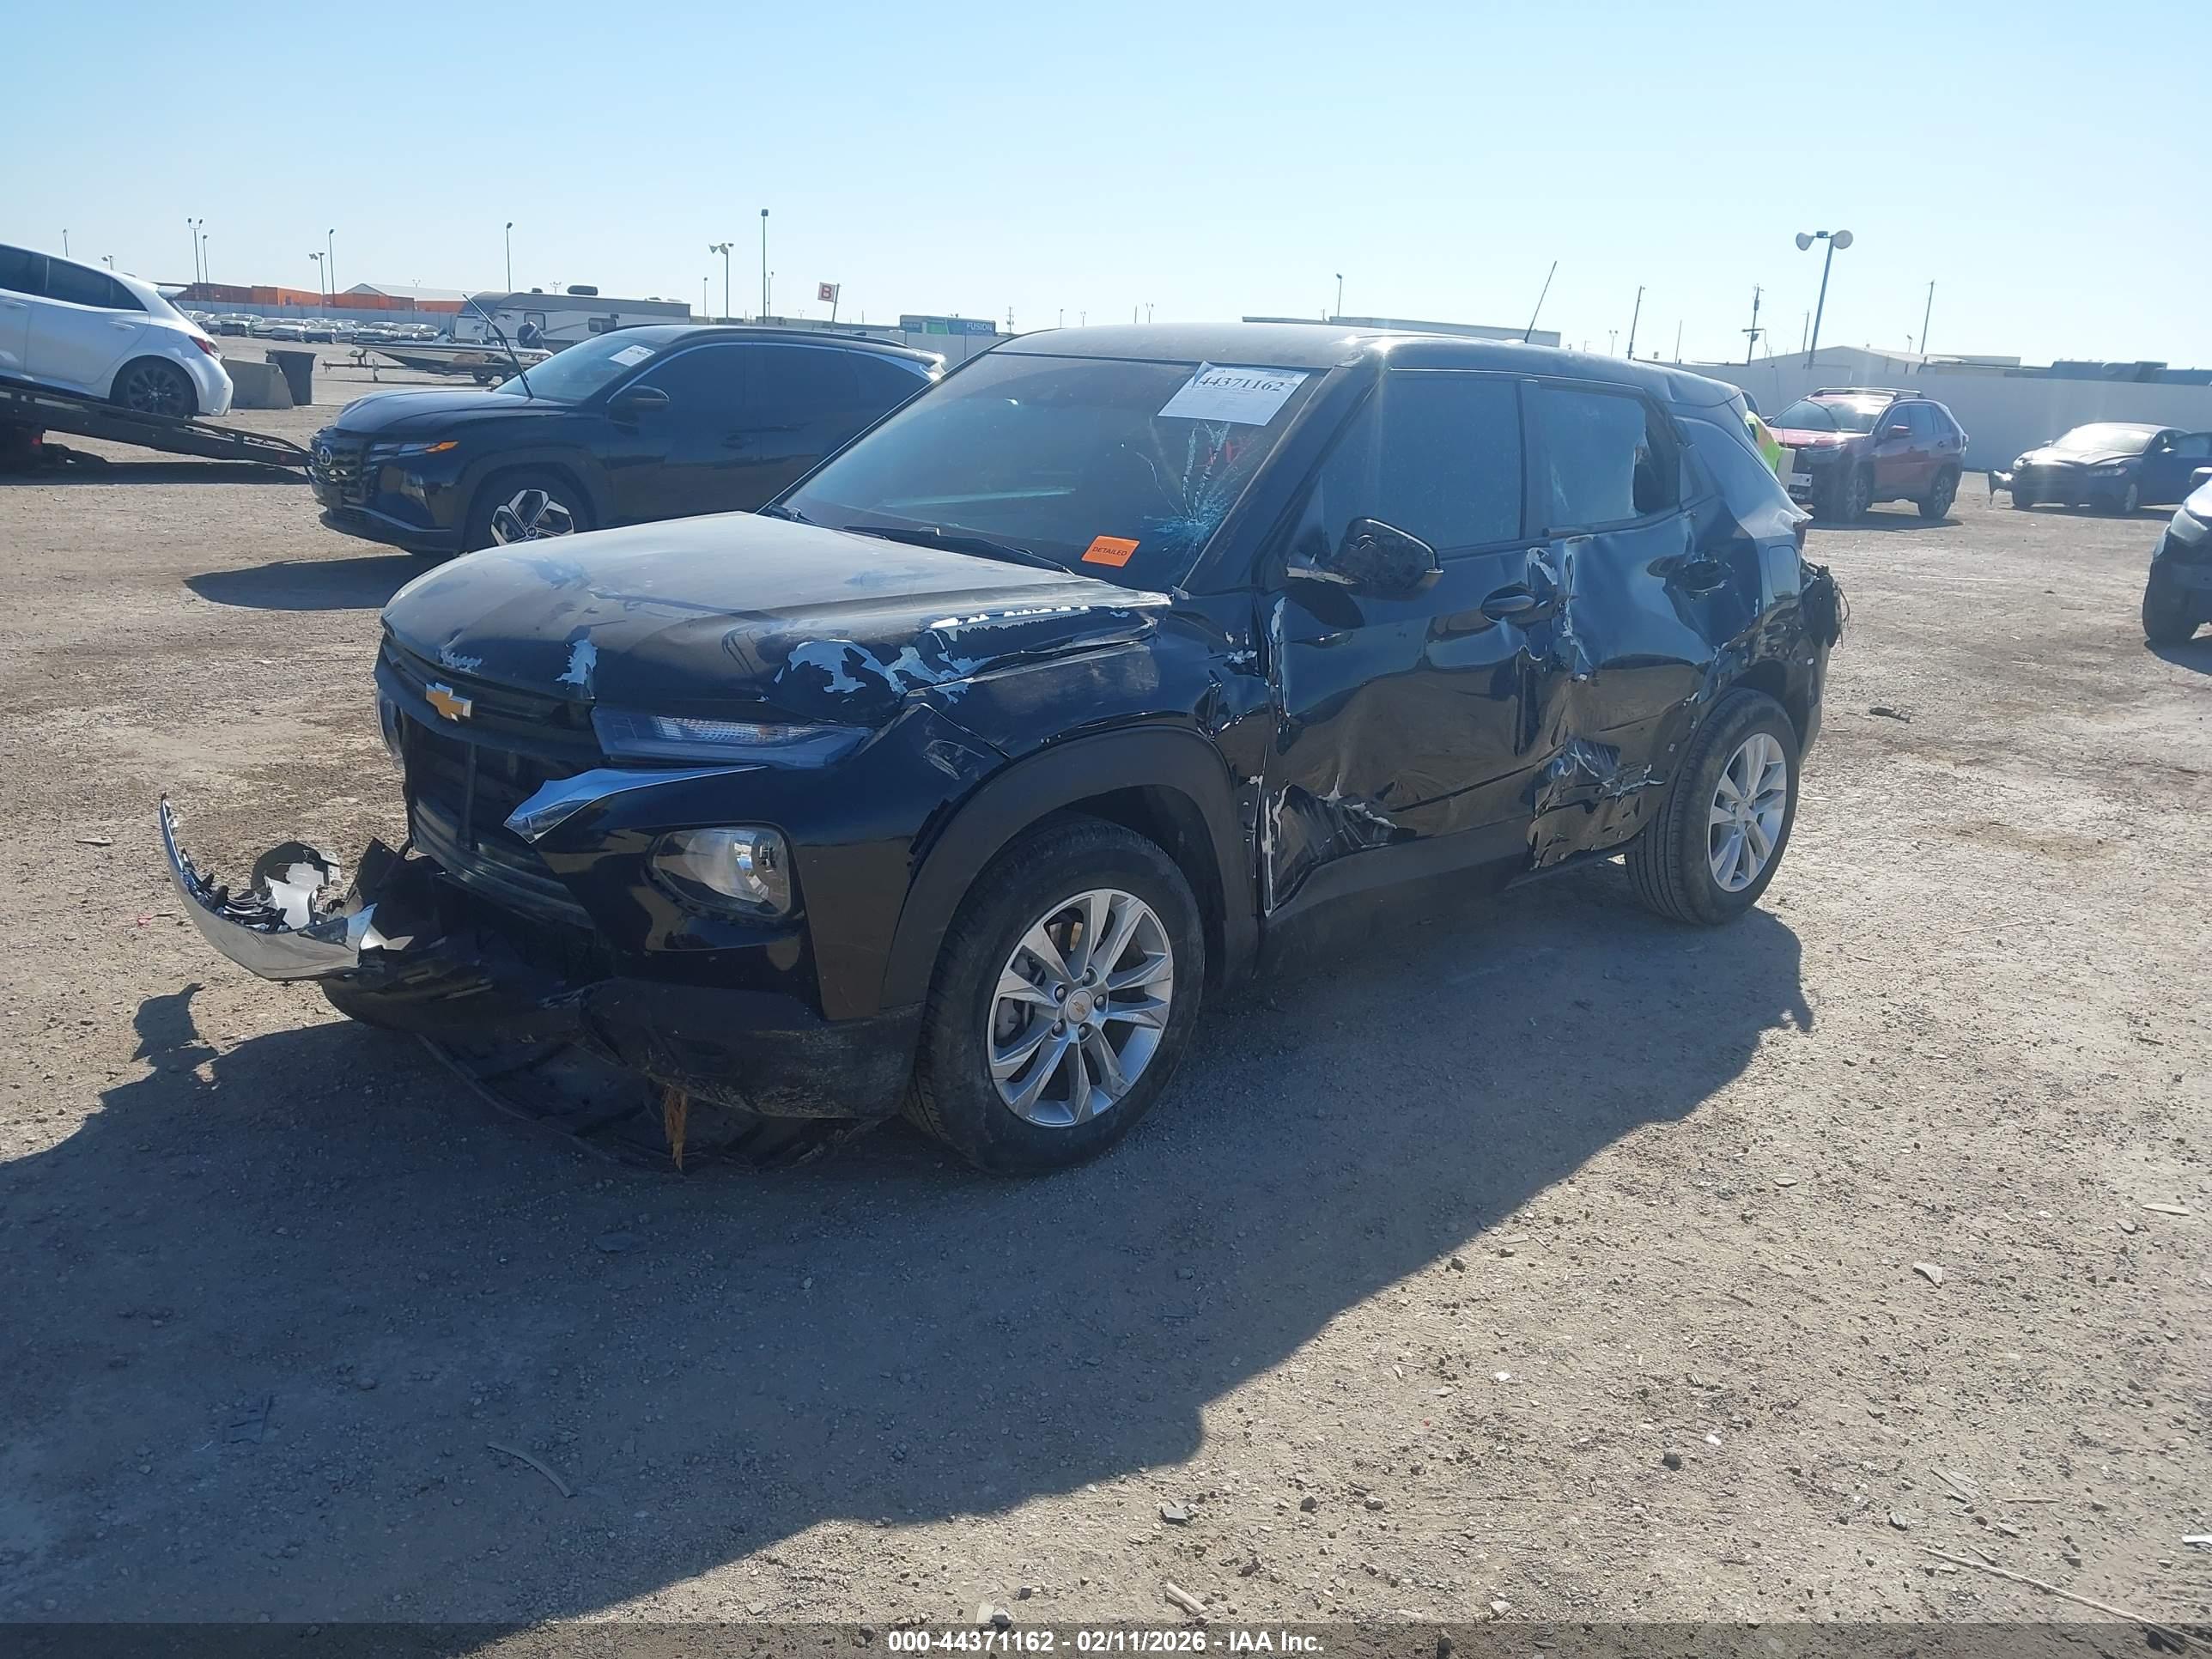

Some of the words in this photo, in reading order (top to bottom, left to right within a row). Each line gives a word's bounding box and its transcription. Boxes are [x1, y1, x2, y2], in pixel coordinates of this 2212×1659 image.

[821, 284, 832, 299] B
[966, 322, 993, 331] FUSION
[1199, 376, 1285, 392] 44371162
[1092, 546, 1127, 556] DETAILED
